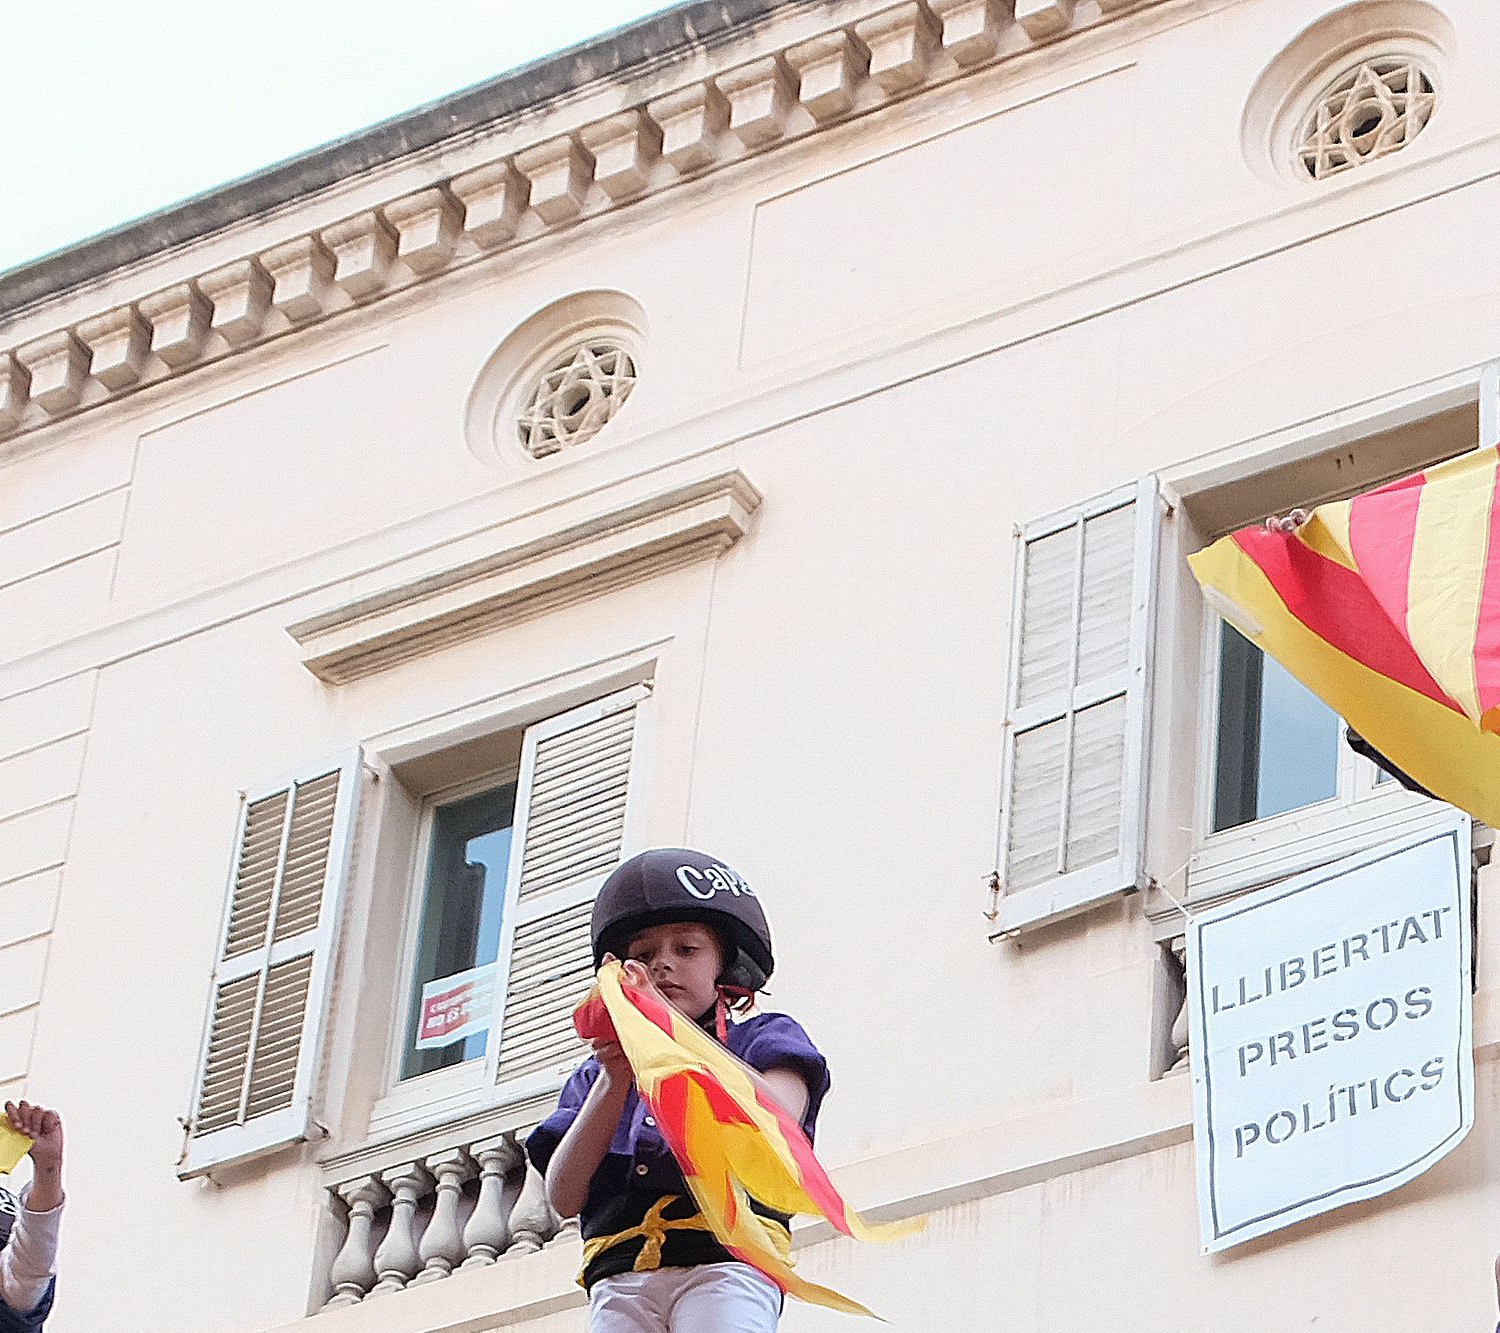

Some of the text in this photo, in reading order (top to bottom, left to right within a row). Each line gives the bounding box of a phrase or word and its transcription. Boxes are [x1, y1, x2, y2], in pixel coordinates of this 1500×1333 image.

[1211, 905, 1452, 1015] LLIBERTAT
[1237, 986, 1434, 1078] PRESOS
[1233, 1056, 1446, 1158] POLÍTICS
